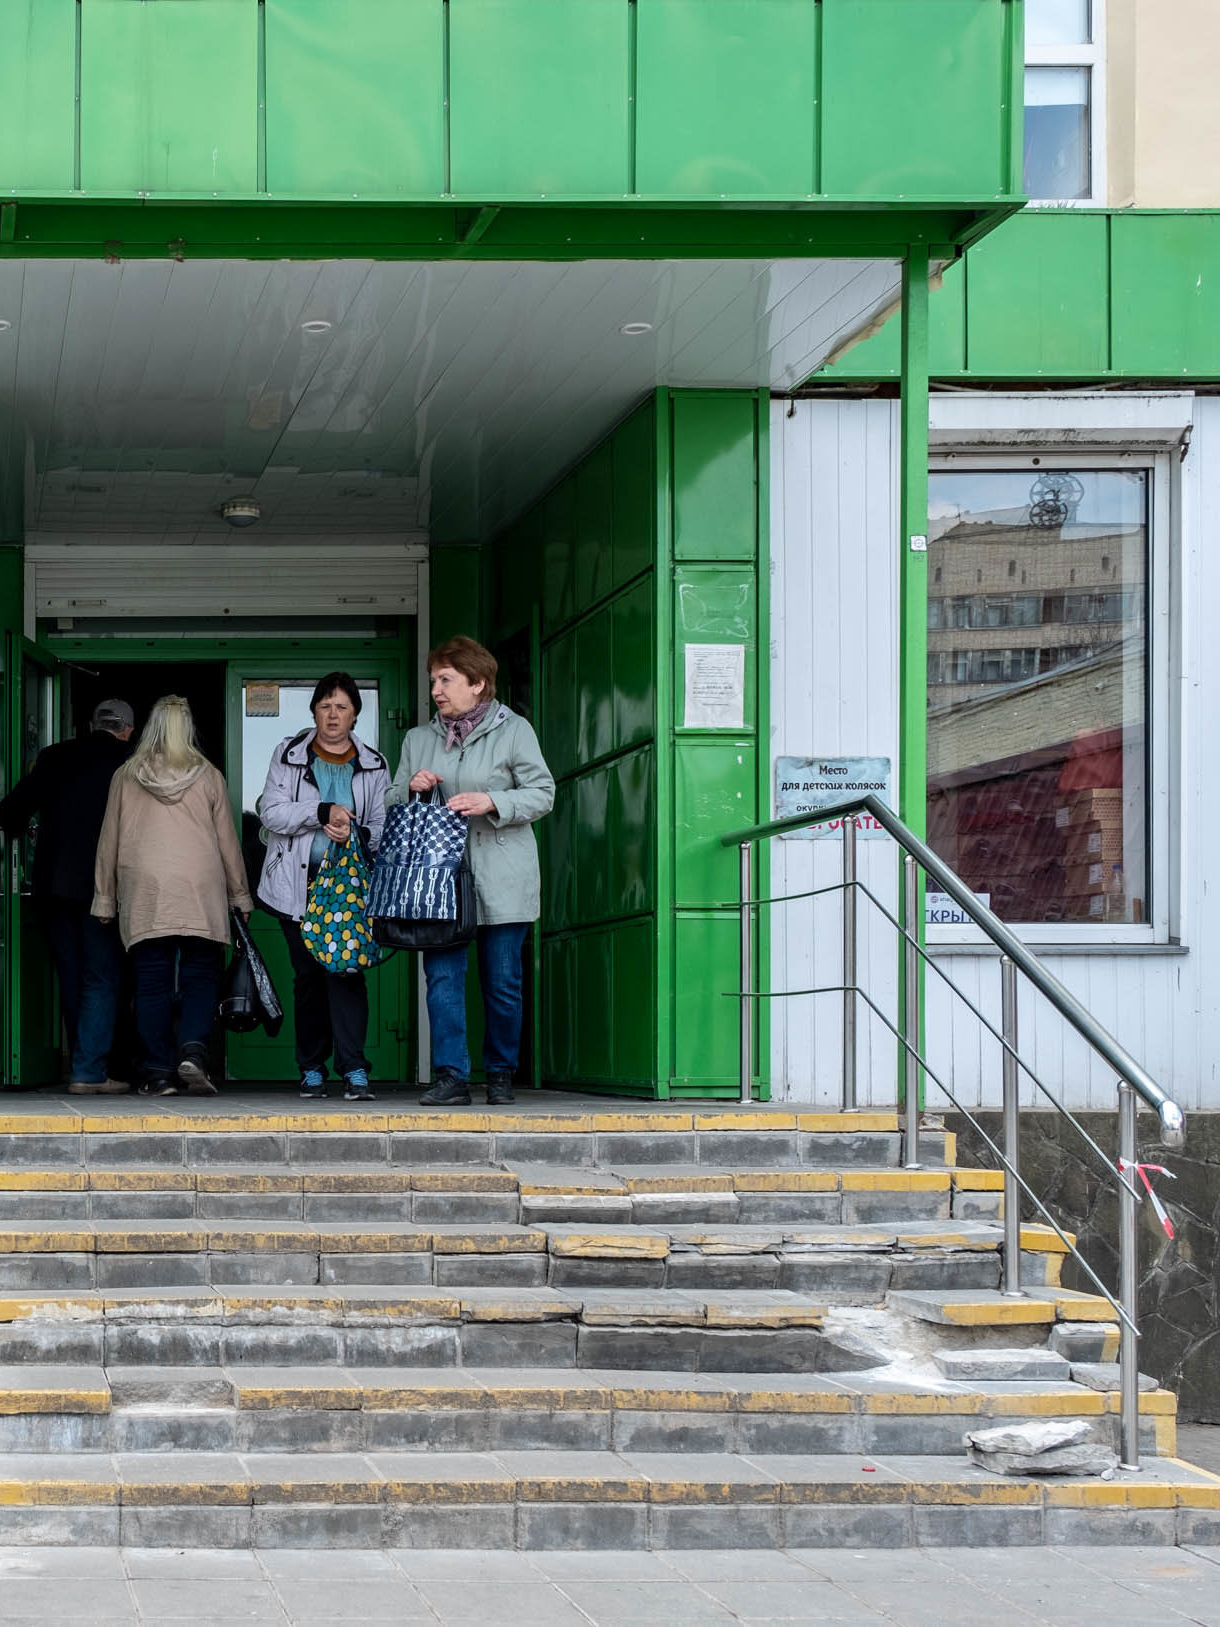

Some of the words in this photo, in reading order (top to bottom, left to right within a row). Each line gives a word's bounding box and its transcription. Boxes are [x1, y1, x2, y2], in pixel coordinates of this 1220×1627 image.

[819, 765, 848, 775] Место
[781, 782, 800, 791] для
[802, 782, 843, 791] детских
[845, 782, 887, 790] колясок
